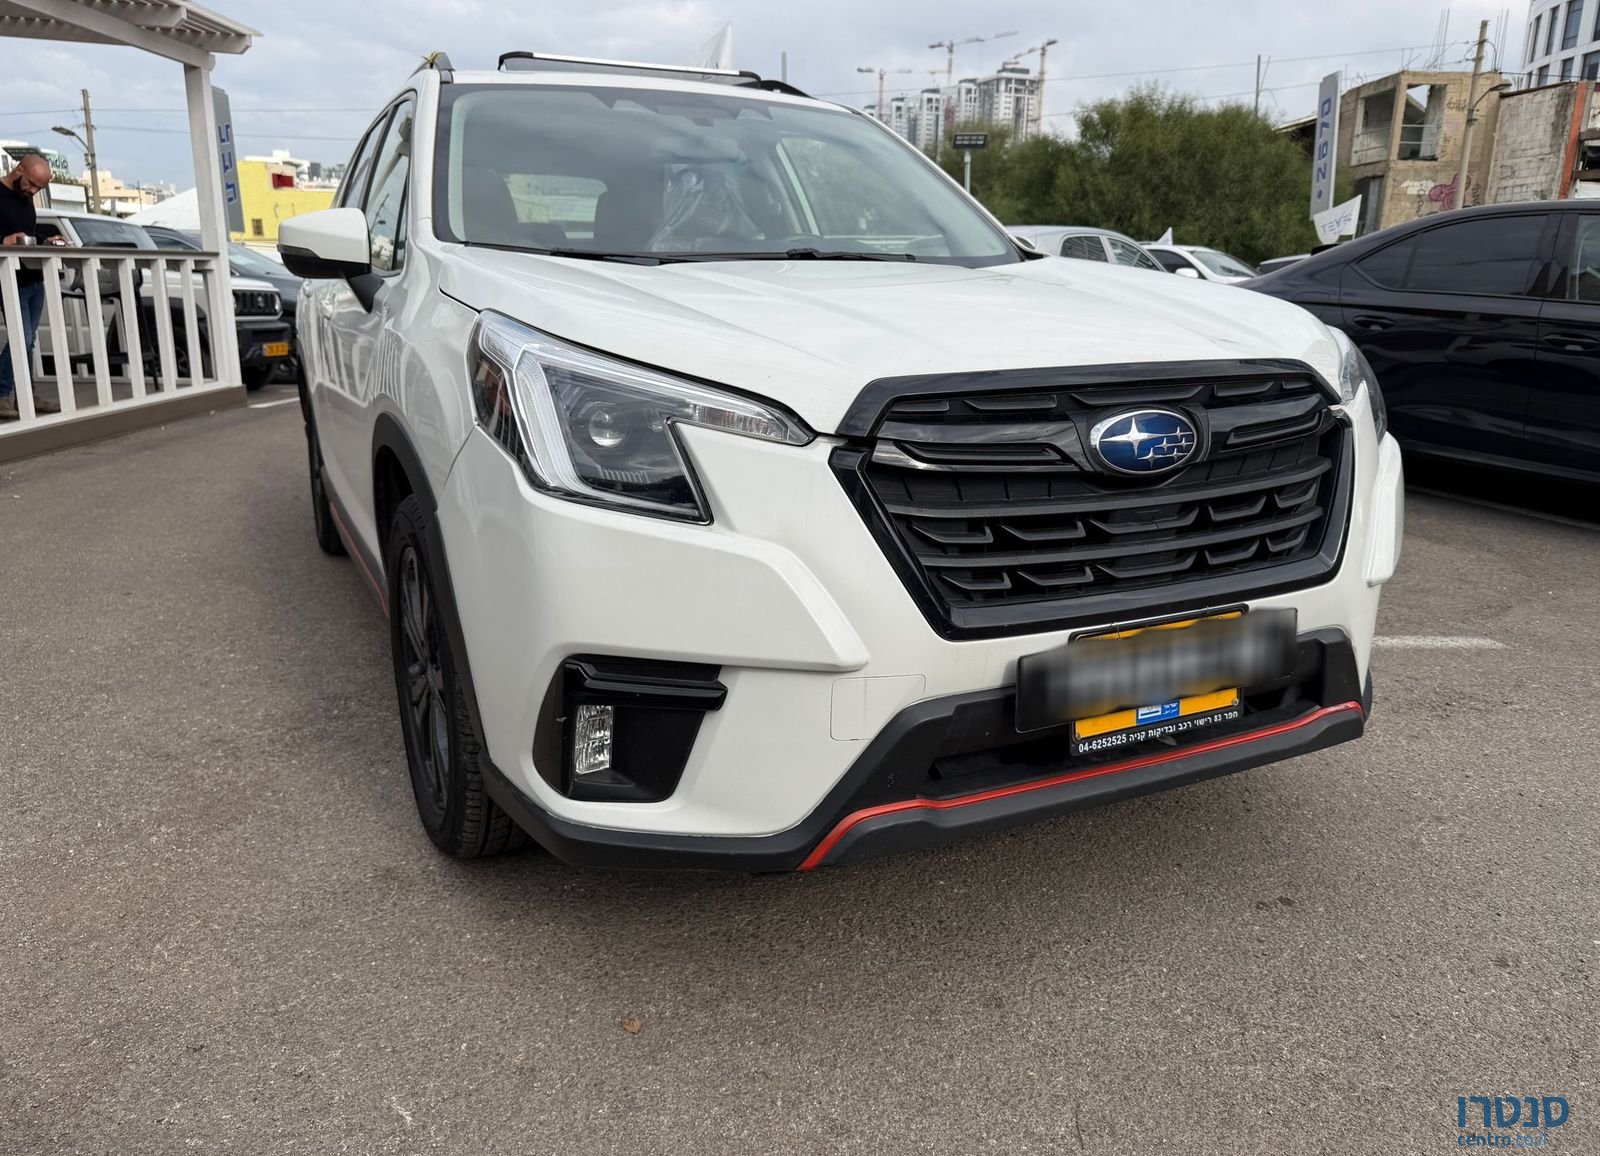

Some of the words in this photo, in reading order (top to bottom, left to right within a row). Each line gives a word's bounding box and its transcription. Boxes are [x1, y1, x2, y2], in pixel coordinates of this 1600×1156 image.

[1178, 721, 1192, 731] רכב
[1193, 716, 1212, 726] רישוי
[1129, 731, 1146, 742] קניה
[1148, 724, 1176, 738] ובדיקות
[1078, 733, 1127, 753] 04-6252525
